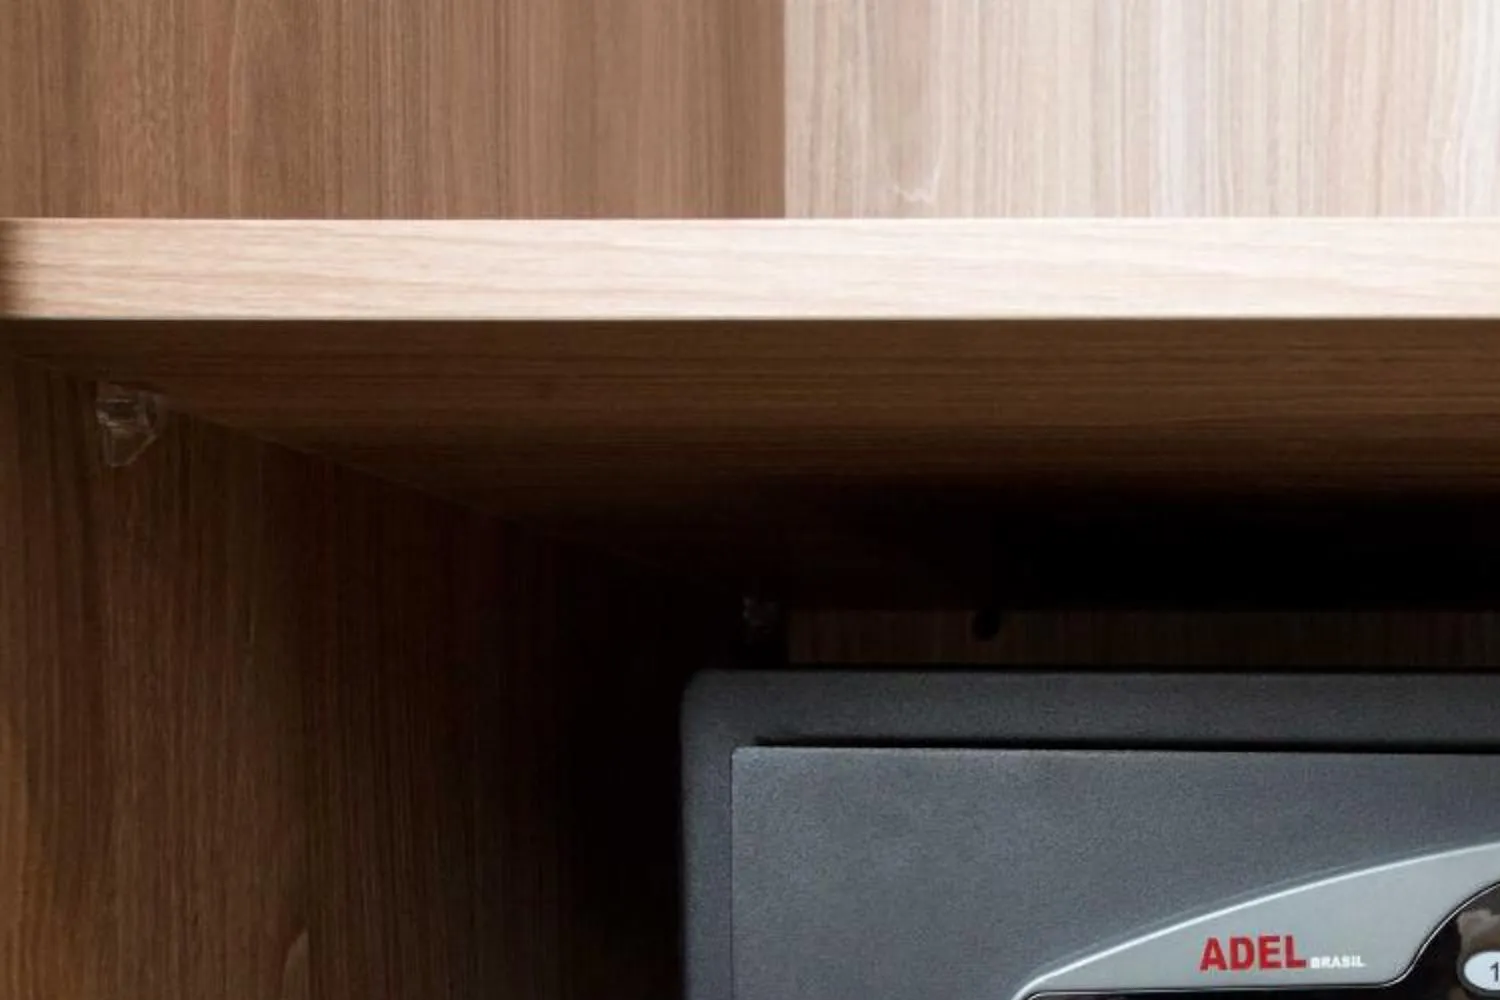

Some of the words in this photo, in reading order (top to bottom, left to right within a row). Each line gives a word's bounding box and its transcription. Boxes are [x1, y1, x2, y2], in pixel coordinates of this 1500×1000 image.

[1199, 934, 1307, 971] ADEL
[1310, 955, 1367, 969] BRASIL
[1490, 962, 1499, 982] 1
